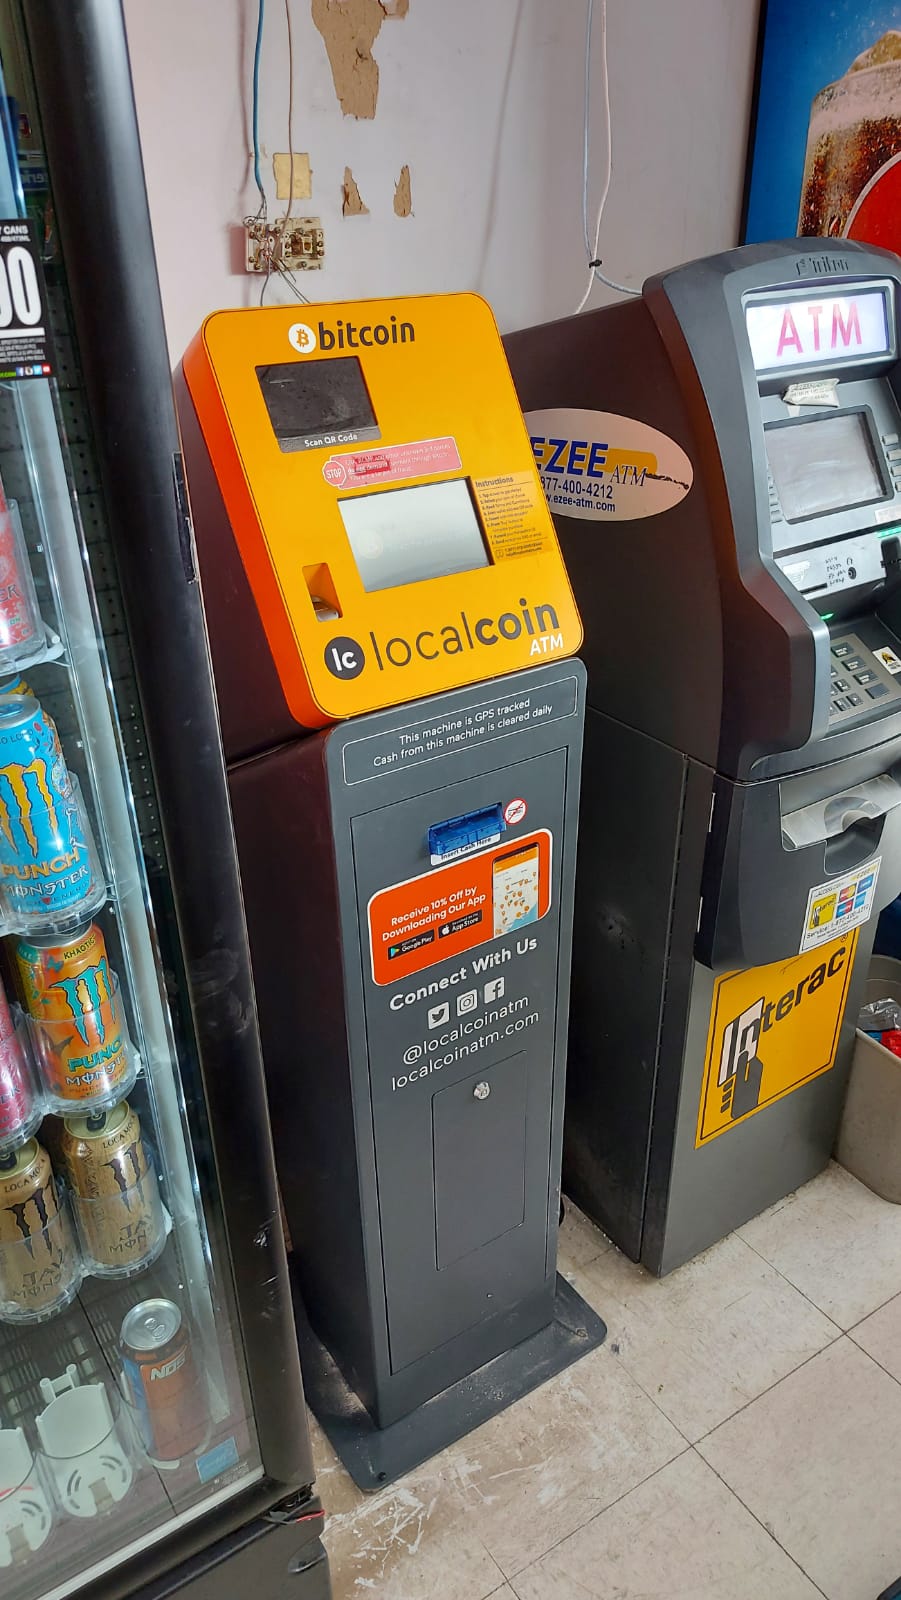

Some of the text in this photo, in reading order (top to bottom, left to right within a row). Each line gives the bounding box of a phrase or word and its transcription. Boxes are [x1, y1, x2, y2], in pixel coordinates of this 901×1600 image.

[318, 315, 415, 351] bitcoin
[776, 301, 863, 358] ATM
[304, 433, 358, 448] Scan QR Code
[325, 467, 342, 480] STOP
[530, 436, 648, 487] EZEE ATM
[475, 476, 514, 489] Instructions
[529, 633, 564, 657] ATM
[373, 704, 553, 768] Cash from this machine is cleared daily
[400, 698, 531, 746] This machine is GPS tracked
[2, 847, 80, 880] PUNCH
[382, 907, 447, 942] Downloading
[448, 900, 466, 914] Our
[467, 893, 487, 909] App
[391, 886, 478, 927] Receive 10% Off by
[452, 917, 479, 932] App Store
[401, 942, 421, 952] Google
[421, 936, 433, 944] Play
[389, 937, 538, 1011] Connect With Us
[403, 996, 529, 1065] @localcoinatm
[391, 1012, 540, 1091] localcoinatm.com
[150, 1352, 186, 1381] NOS
